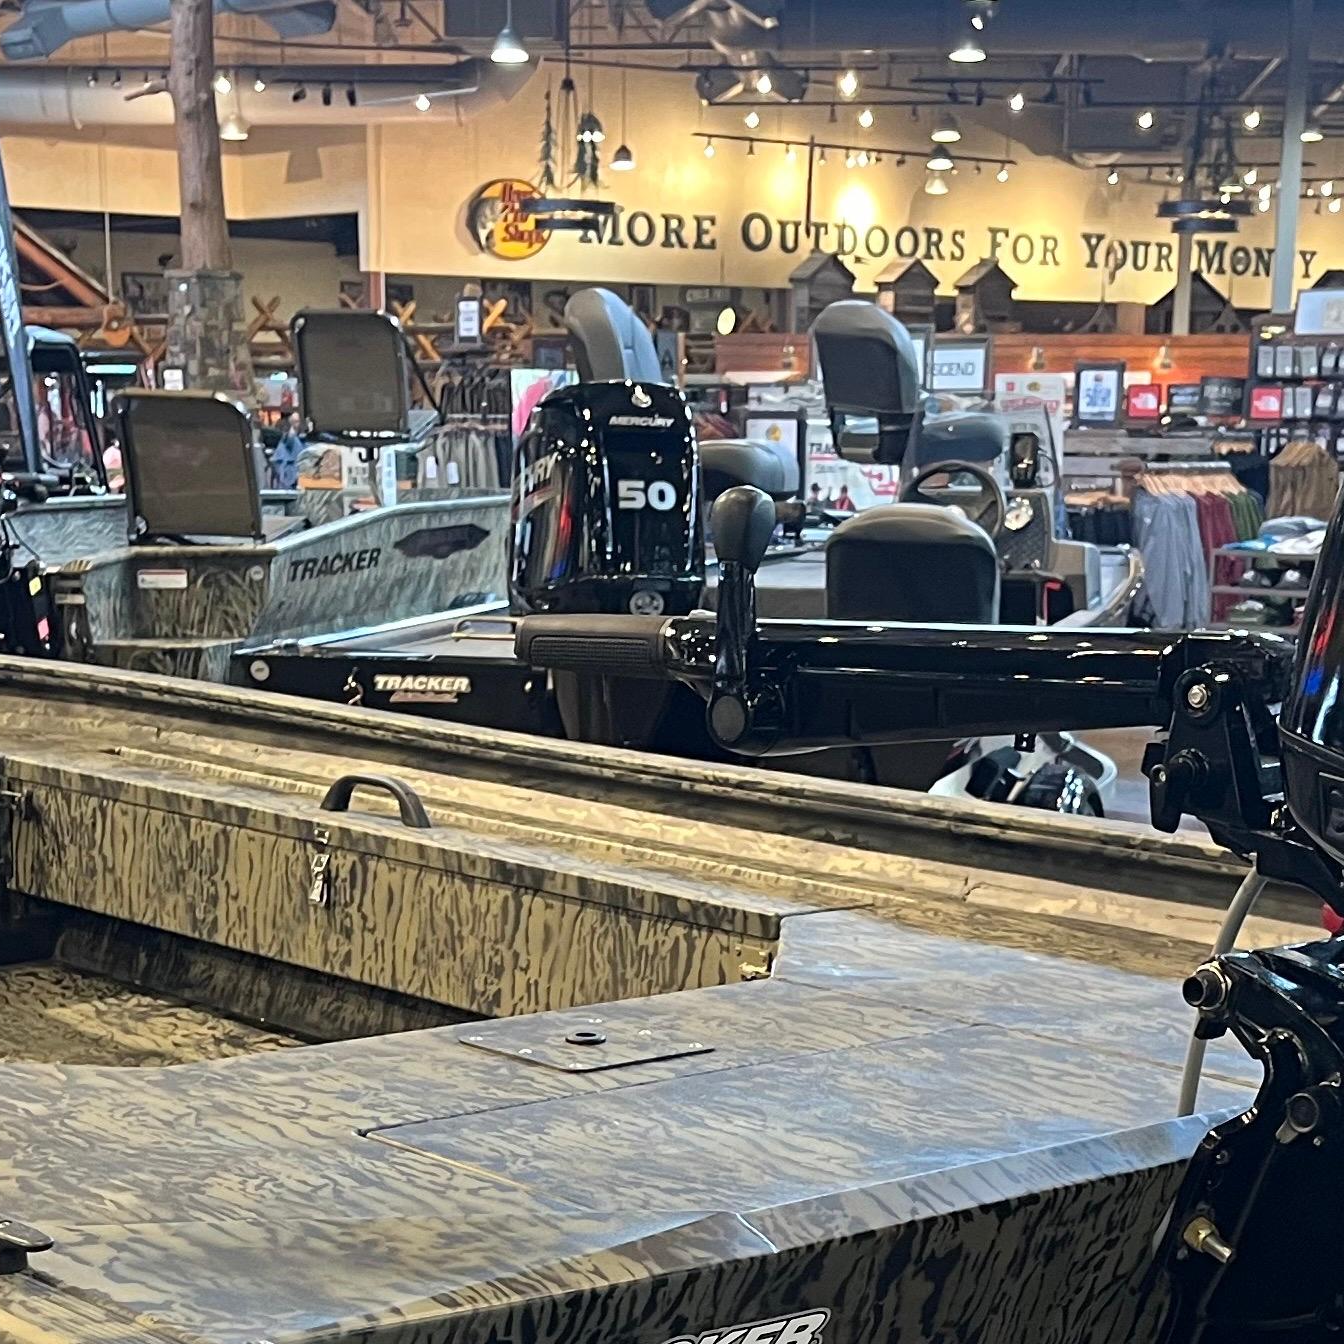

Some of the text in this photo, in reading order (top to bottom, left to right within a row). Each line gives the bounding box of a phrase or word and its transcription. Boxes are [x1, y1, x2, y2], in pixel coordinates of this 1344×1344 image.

[578, 205, 1318, 279] MORE OUTDOORS FOR YOUR MONY
[608, 415, 676, 428] MERCURY
[617, 479, 677, 511] 50
[290, 548, 382, 582] TRACKER
[374, 675, 471, 693] TRACKER
